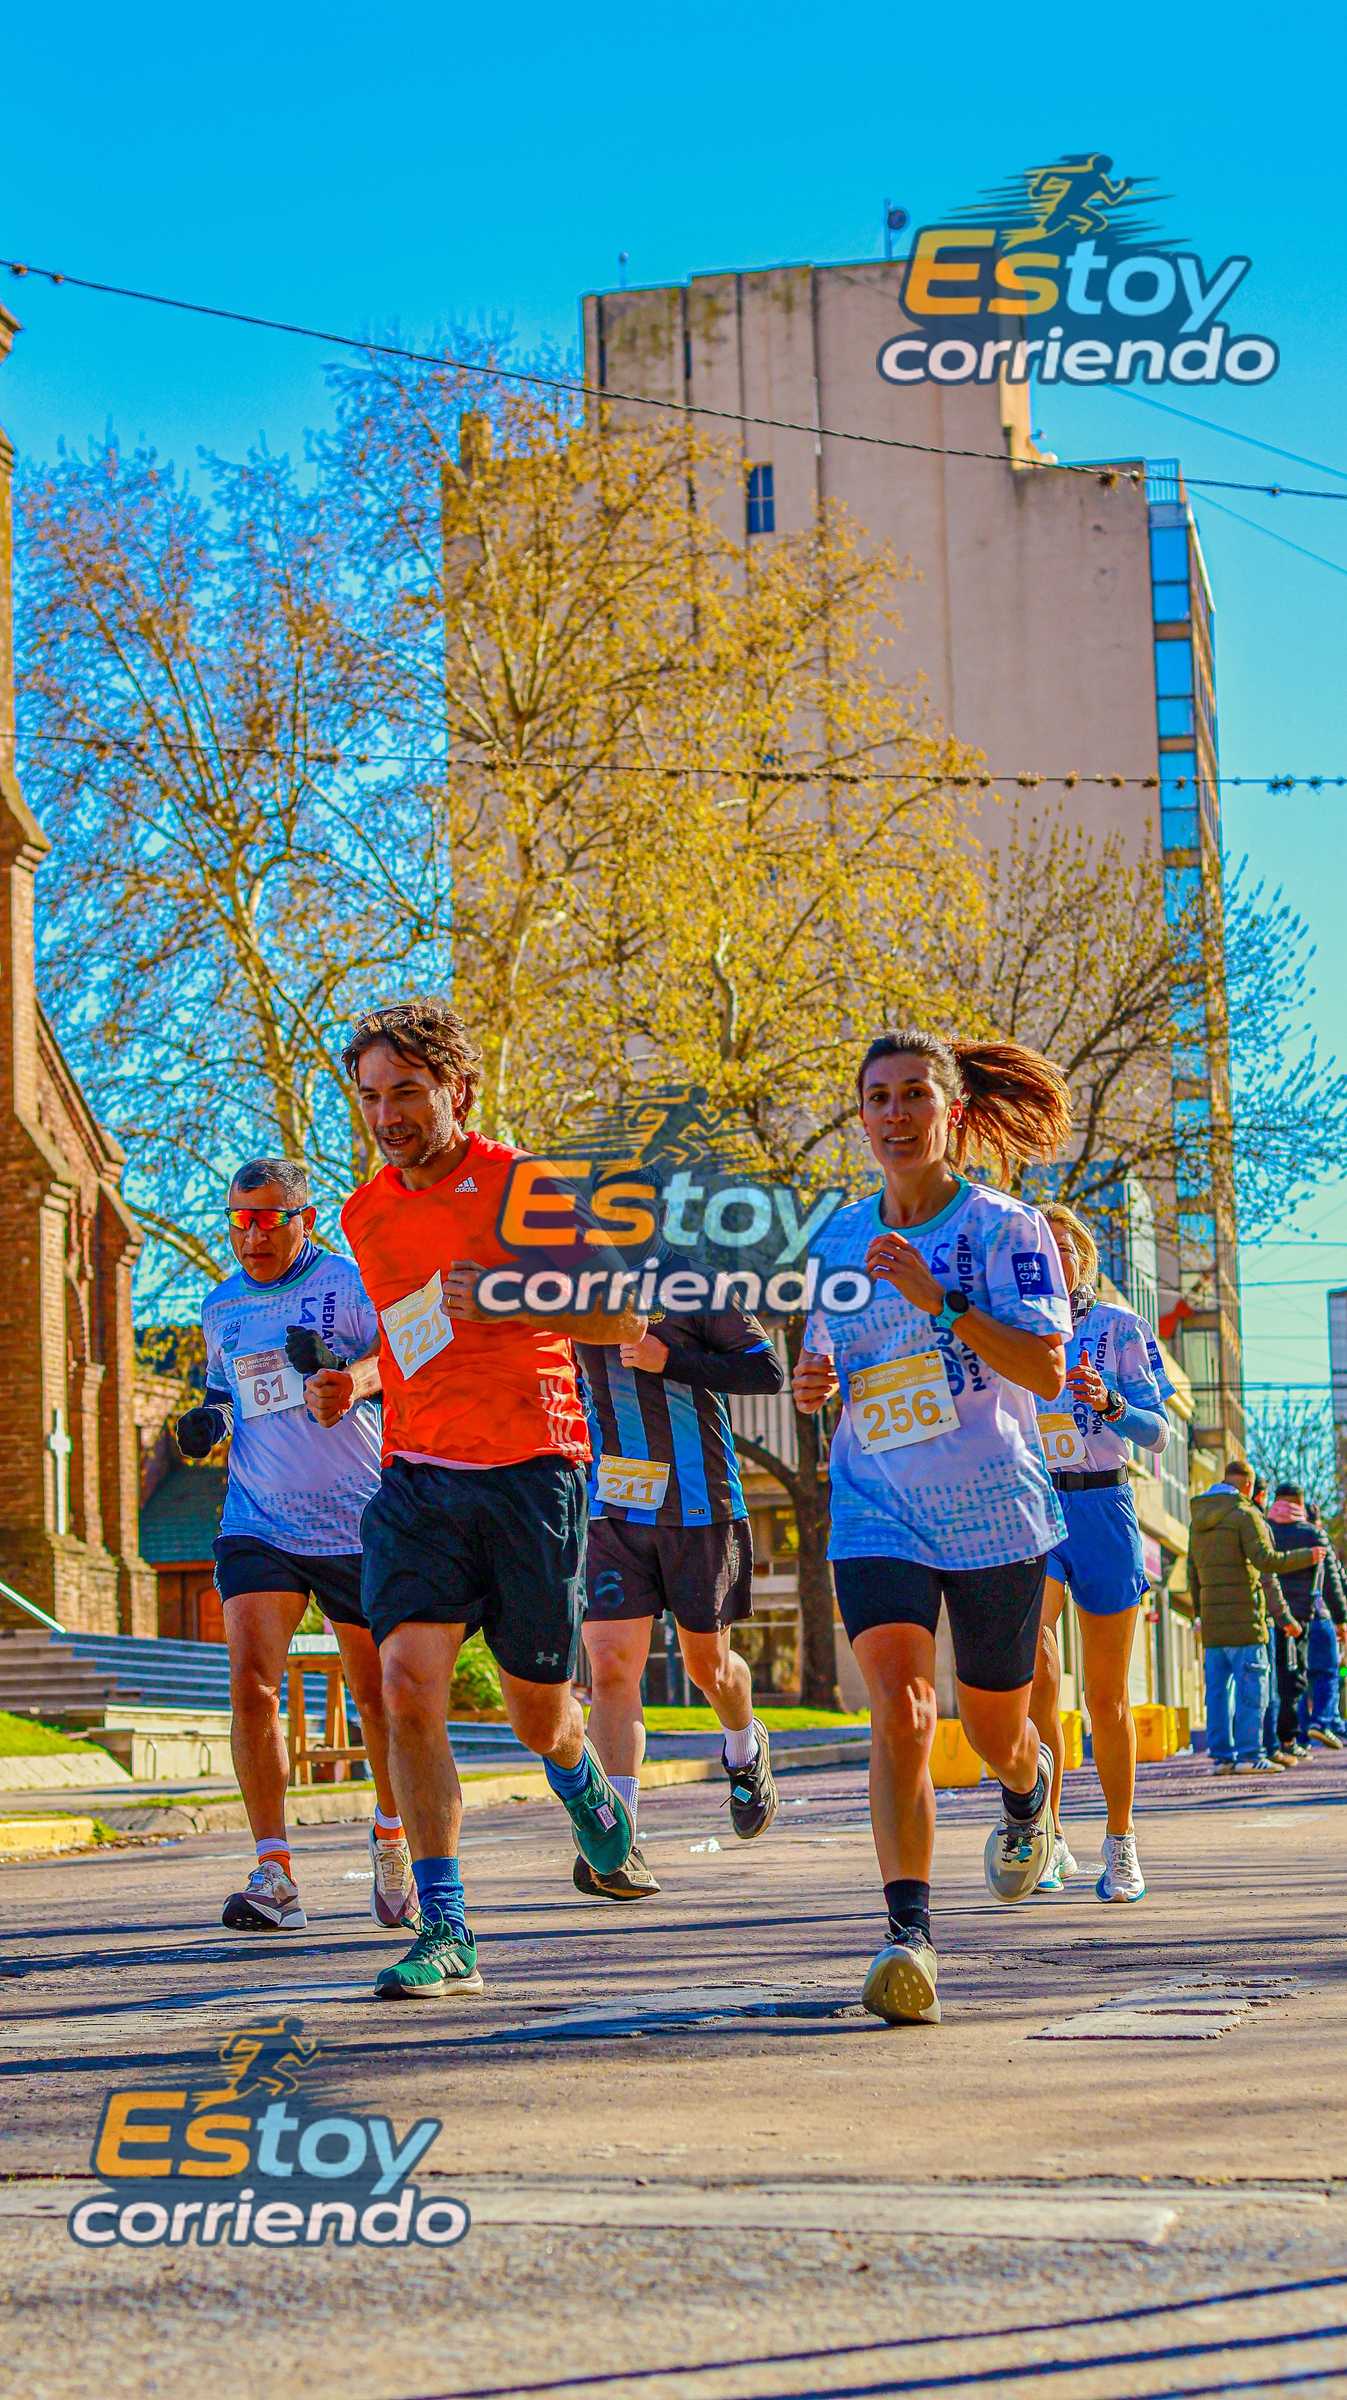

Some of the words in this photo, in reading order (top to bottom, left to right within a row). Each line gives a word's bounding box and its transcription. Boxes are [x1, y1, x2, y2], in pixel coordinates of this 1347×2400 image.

[299, 1296, 318, 1324] LA
[322, 1291, 337, 1340] MEDIA
[398, 1310, 447, 1366] 221
[253, 1374, 288, 1406] 61
[863, 1388, 941, 1442] 256
[604, 1477, 657, 1504] 211
